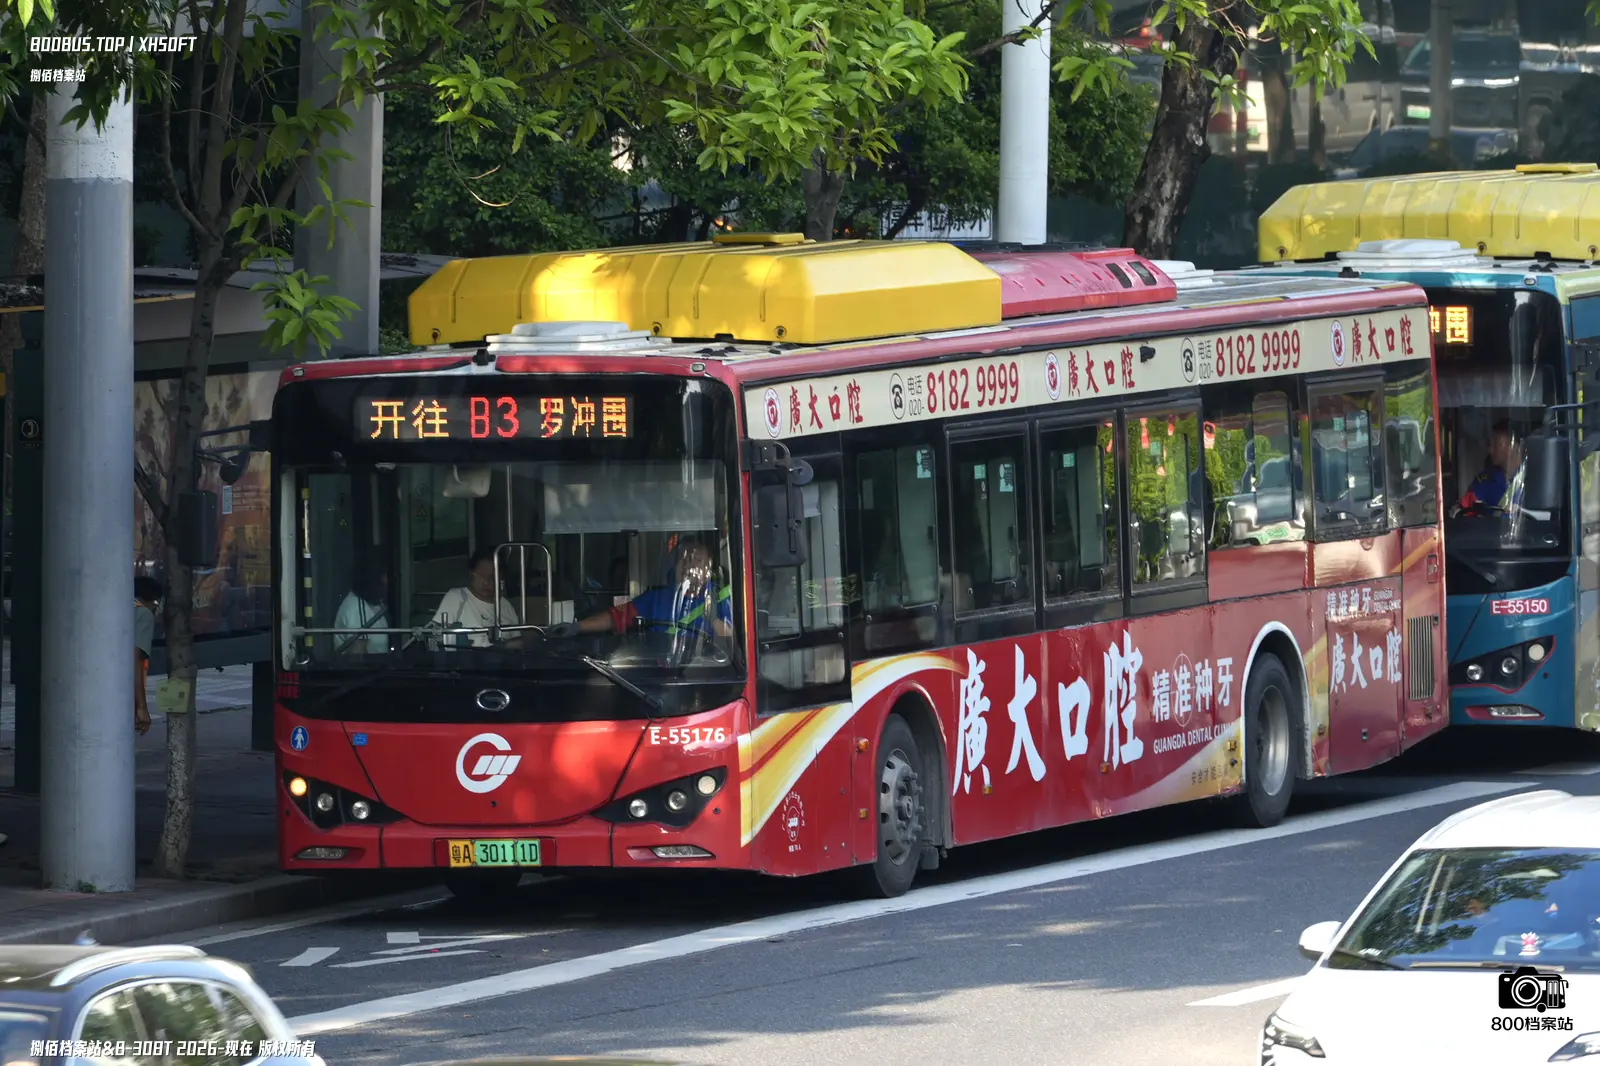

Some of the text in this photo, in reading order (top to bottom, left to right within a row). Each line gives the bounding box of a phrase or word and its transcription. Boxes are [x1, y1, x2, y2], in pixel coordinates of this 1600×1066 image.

[1216, 329, 1301, 377] 8182 9999
[1352, 313, 1413, 363] 廣大口腔
[907, 375, 922, 396] 电话
[927, 361, 1019, 414] 8182 9999
[1068, 345, 1135, 397] 廣大口腔
[370, 399, 450, 439] 开往
[470, 396, 520, 439] B3
[789, 378, 863, 435] 廣大口腔
[1492, 599, 1547, 614] E-55150
[1329, 626, 1402, 694] 廣大口腔
[952, 629, 1144, 797] 廣大口腔
[1152, 657, 1233, 723] 精准种牙
[650, 727, 726, 745] E-55176
[1153, 732, 1187, 755] GUANGDA
[1187, 726, 1213, 747] DENTAL
[452, 843, 538, 864] 粤A 30111D
